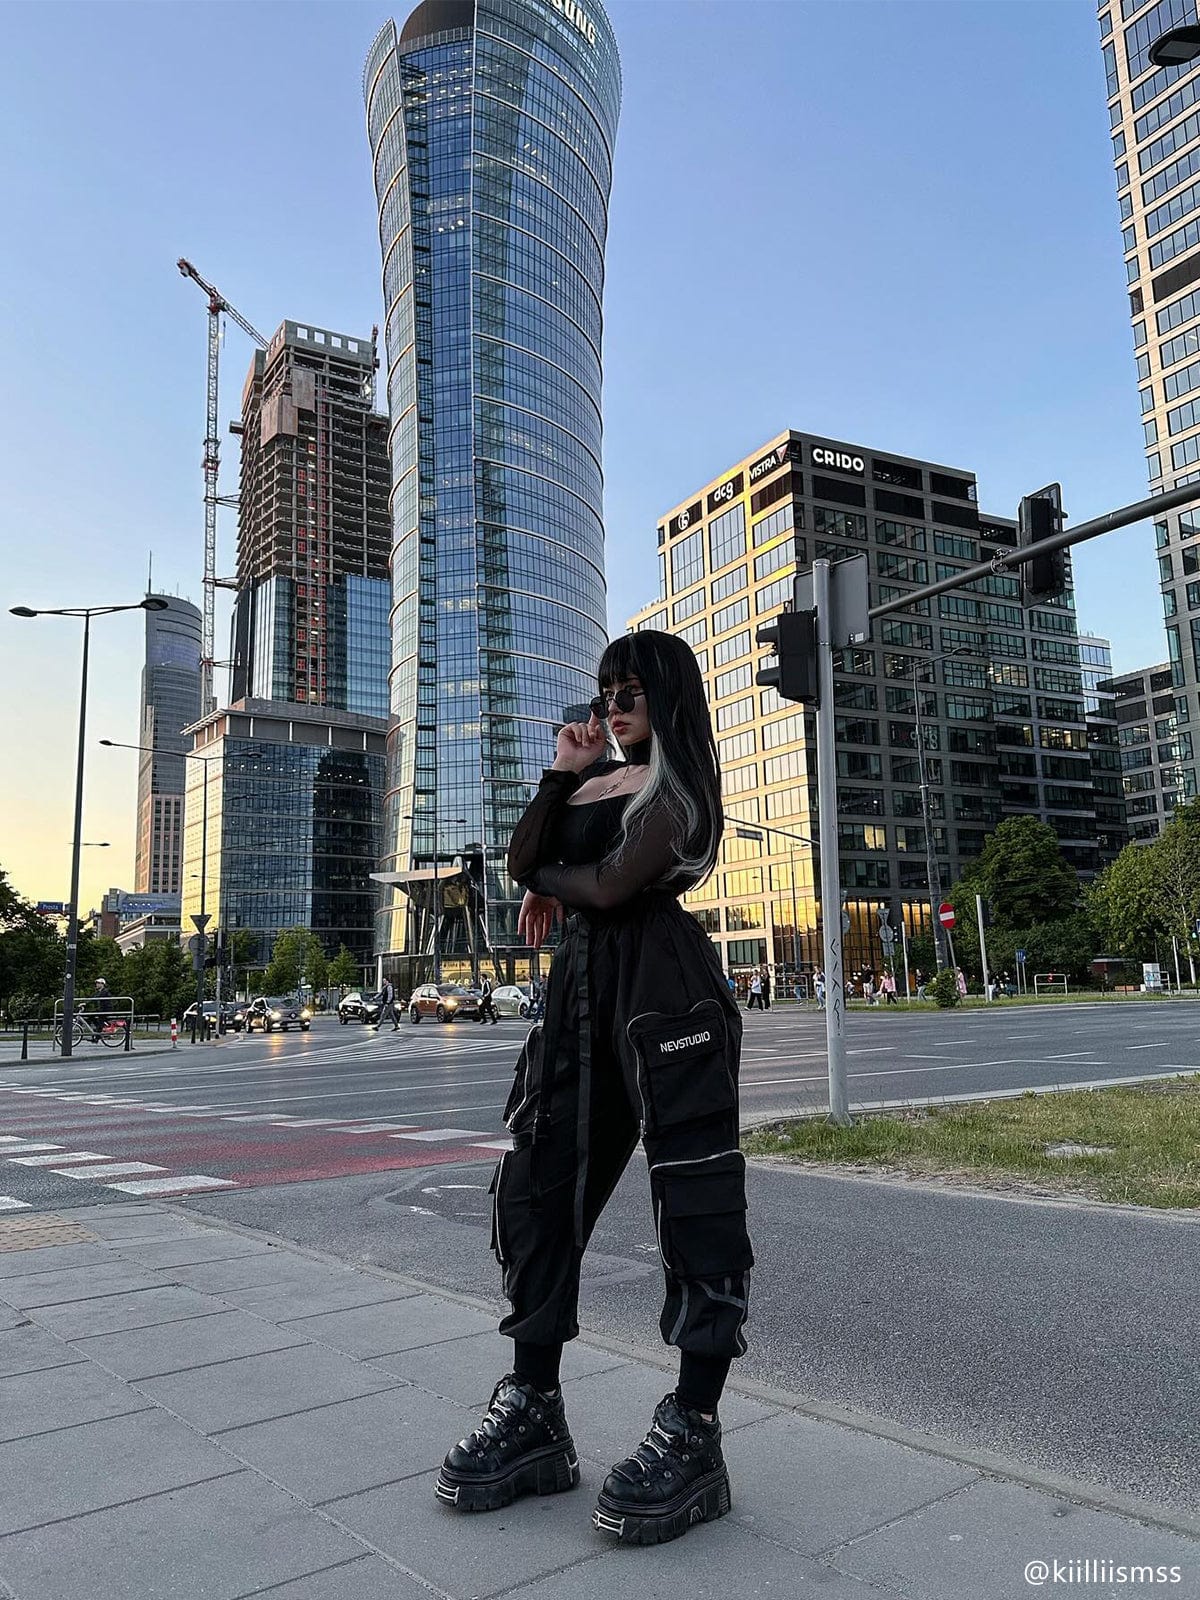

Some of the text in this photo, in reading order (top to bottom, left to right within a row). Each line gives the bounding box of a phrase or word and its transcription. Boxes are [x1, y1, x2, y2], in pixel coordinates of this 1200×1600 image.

[749, 455, 776, 480] VISTRA
[813, 448, 864, 471] CRIDO
[714, 482, 733, 502] dcg
[660, 1031, 710, 1052] NEVSTUDIO
